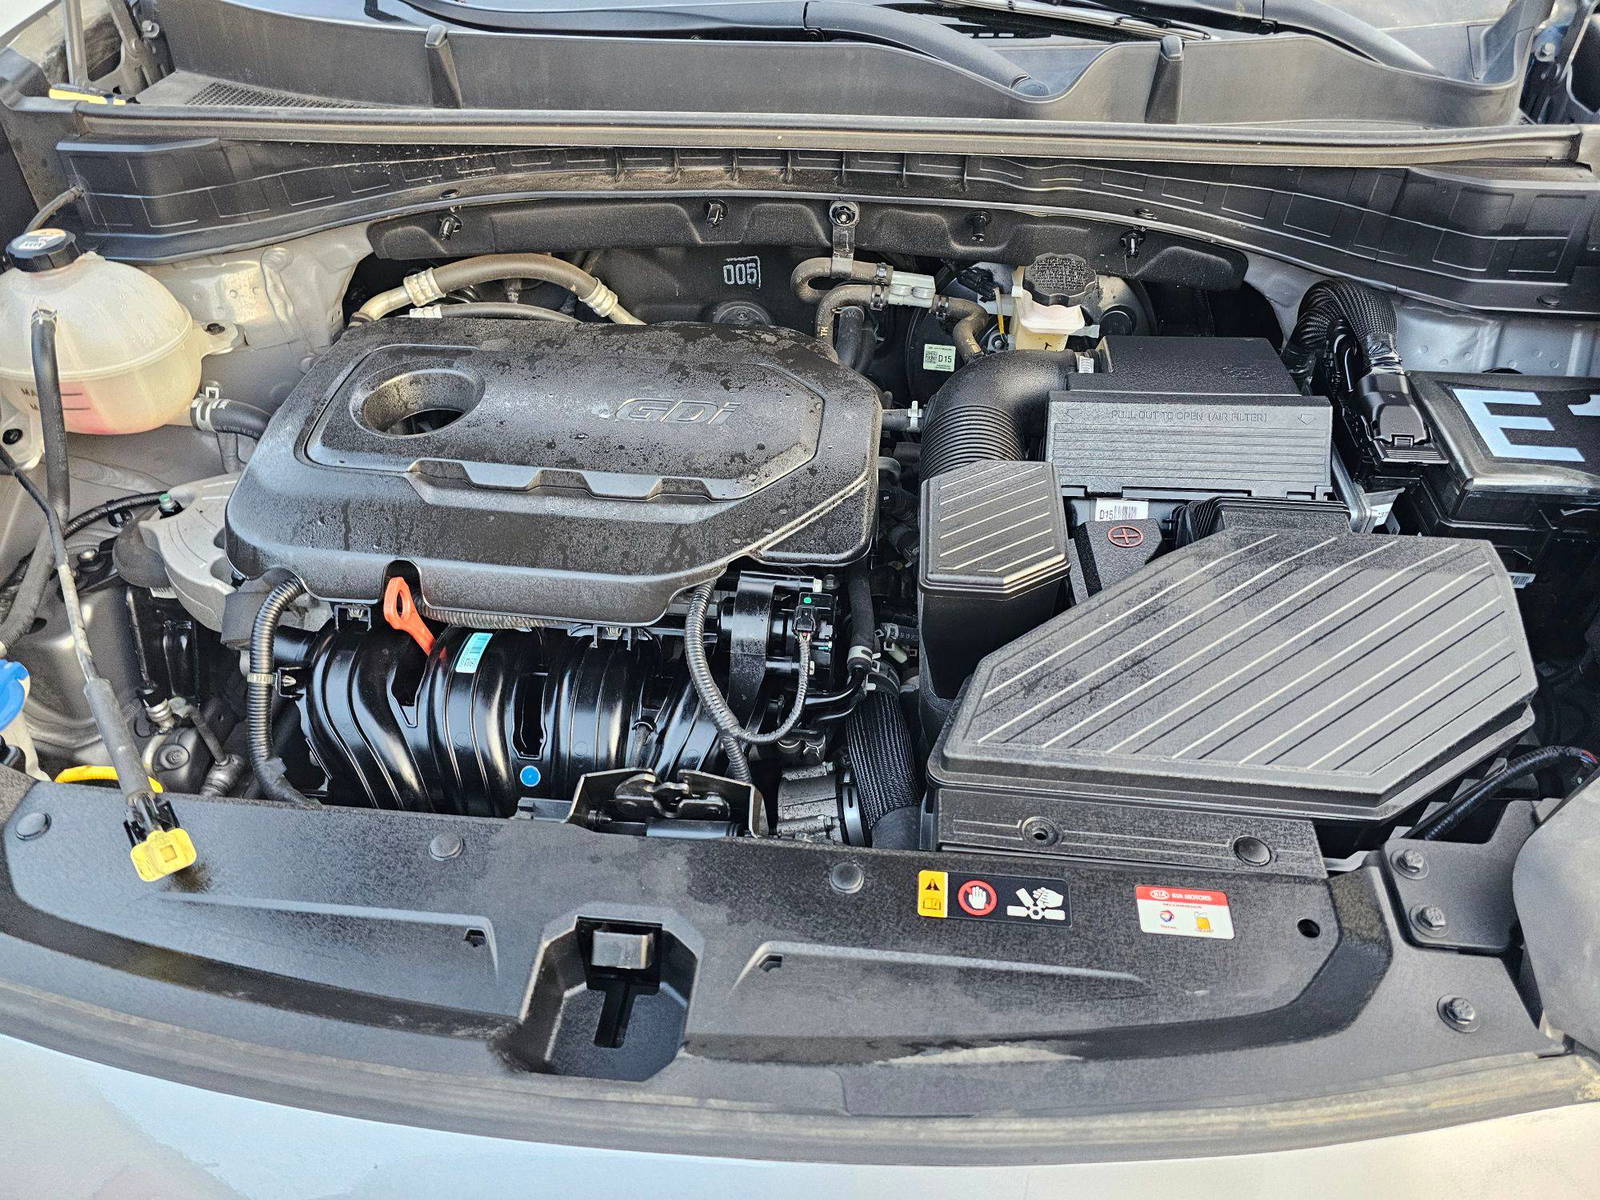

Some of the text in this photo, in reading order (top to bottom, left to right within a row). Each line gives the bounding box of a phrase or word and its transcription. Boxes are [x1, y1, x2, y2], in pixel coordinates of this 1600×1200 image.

[938, 354, 952, 363] D15
[615, 398, 741, 425] GDi
[1111, 410, 1136, 419] PULL
[1139, 410, 1160, 420] OUT
[1162, 411, 1174, 420] TO
[1176, 411, 1203, 421] OPEN
[1100, 509, 1115, 520] D15
